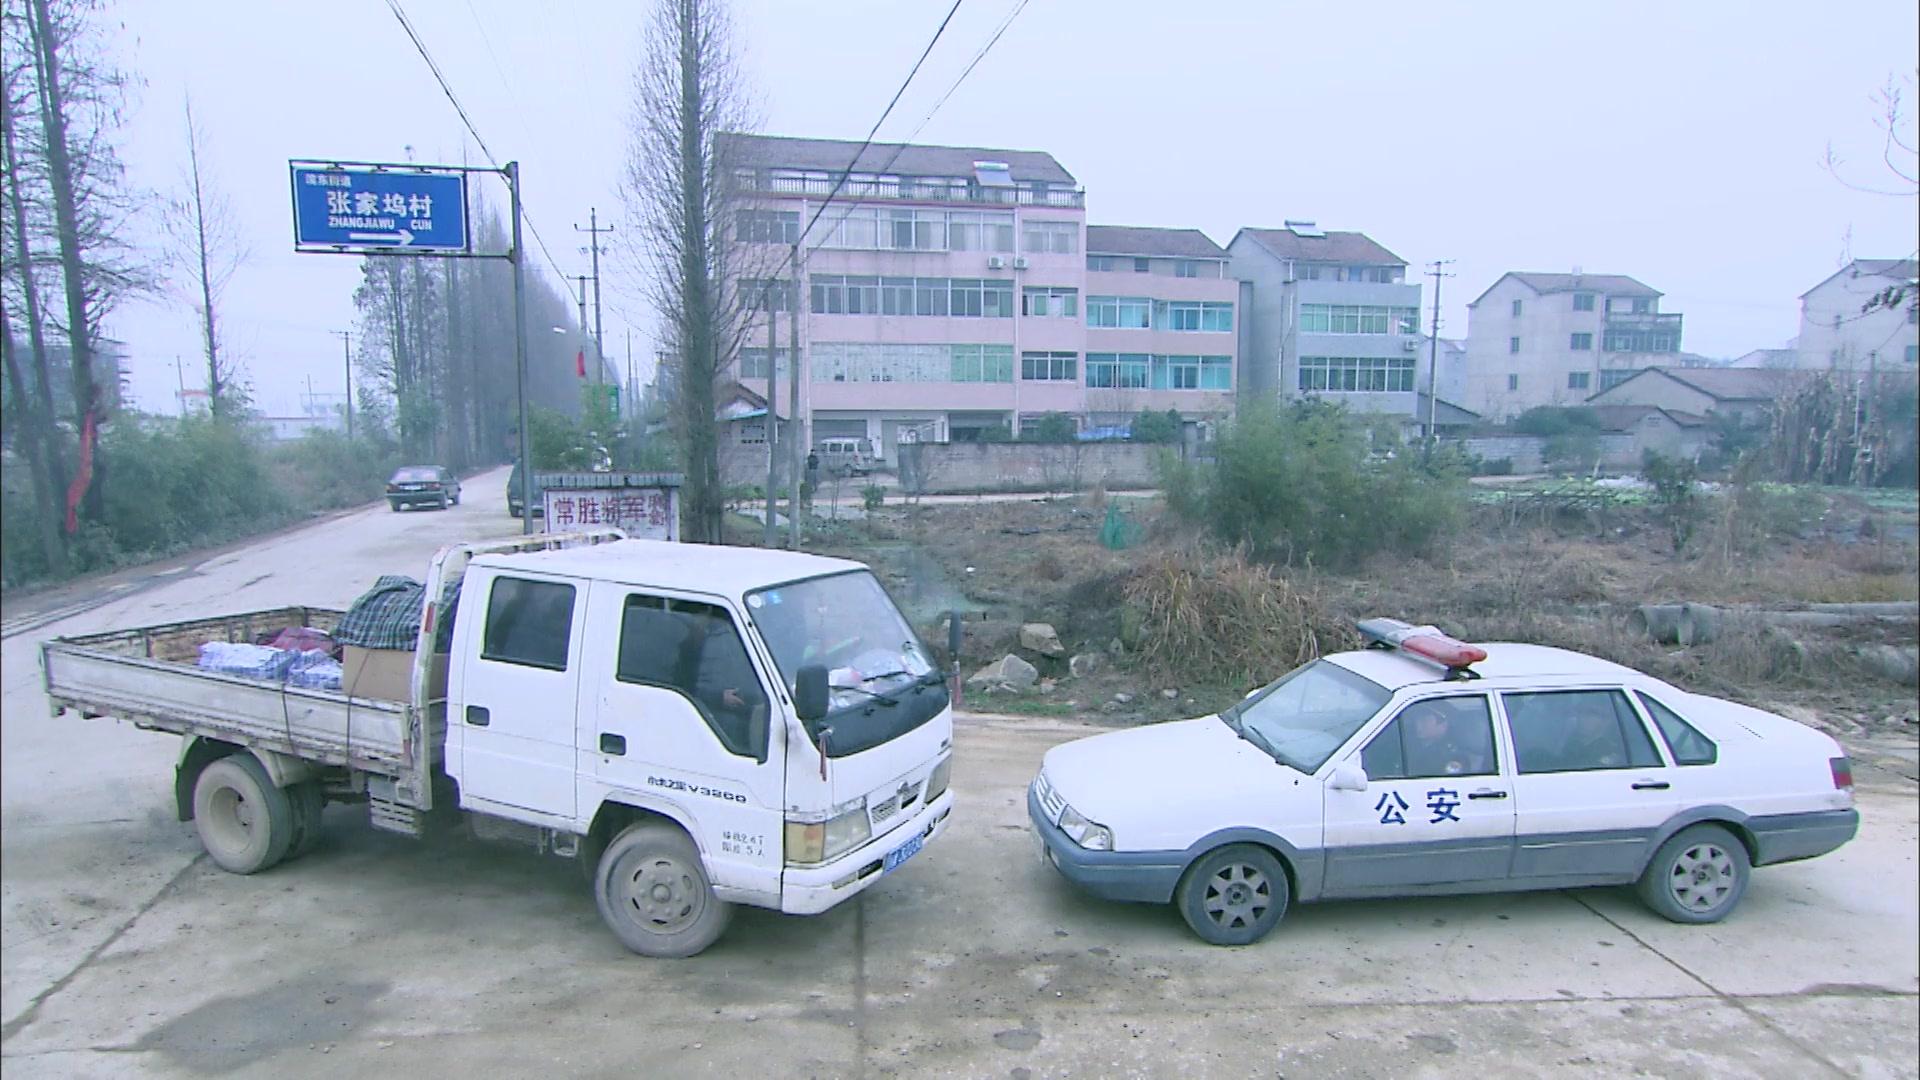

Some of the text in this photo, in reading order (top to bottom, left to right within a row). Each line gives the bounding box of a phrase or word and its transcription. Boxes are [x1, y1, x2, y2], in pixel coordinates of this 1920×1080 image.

[326, 190, 433, 218] 张家坞村
[328, 215, 432, 231] ZHANGJIAWU CUN
[1374, 787, 1461, 825] 公安
